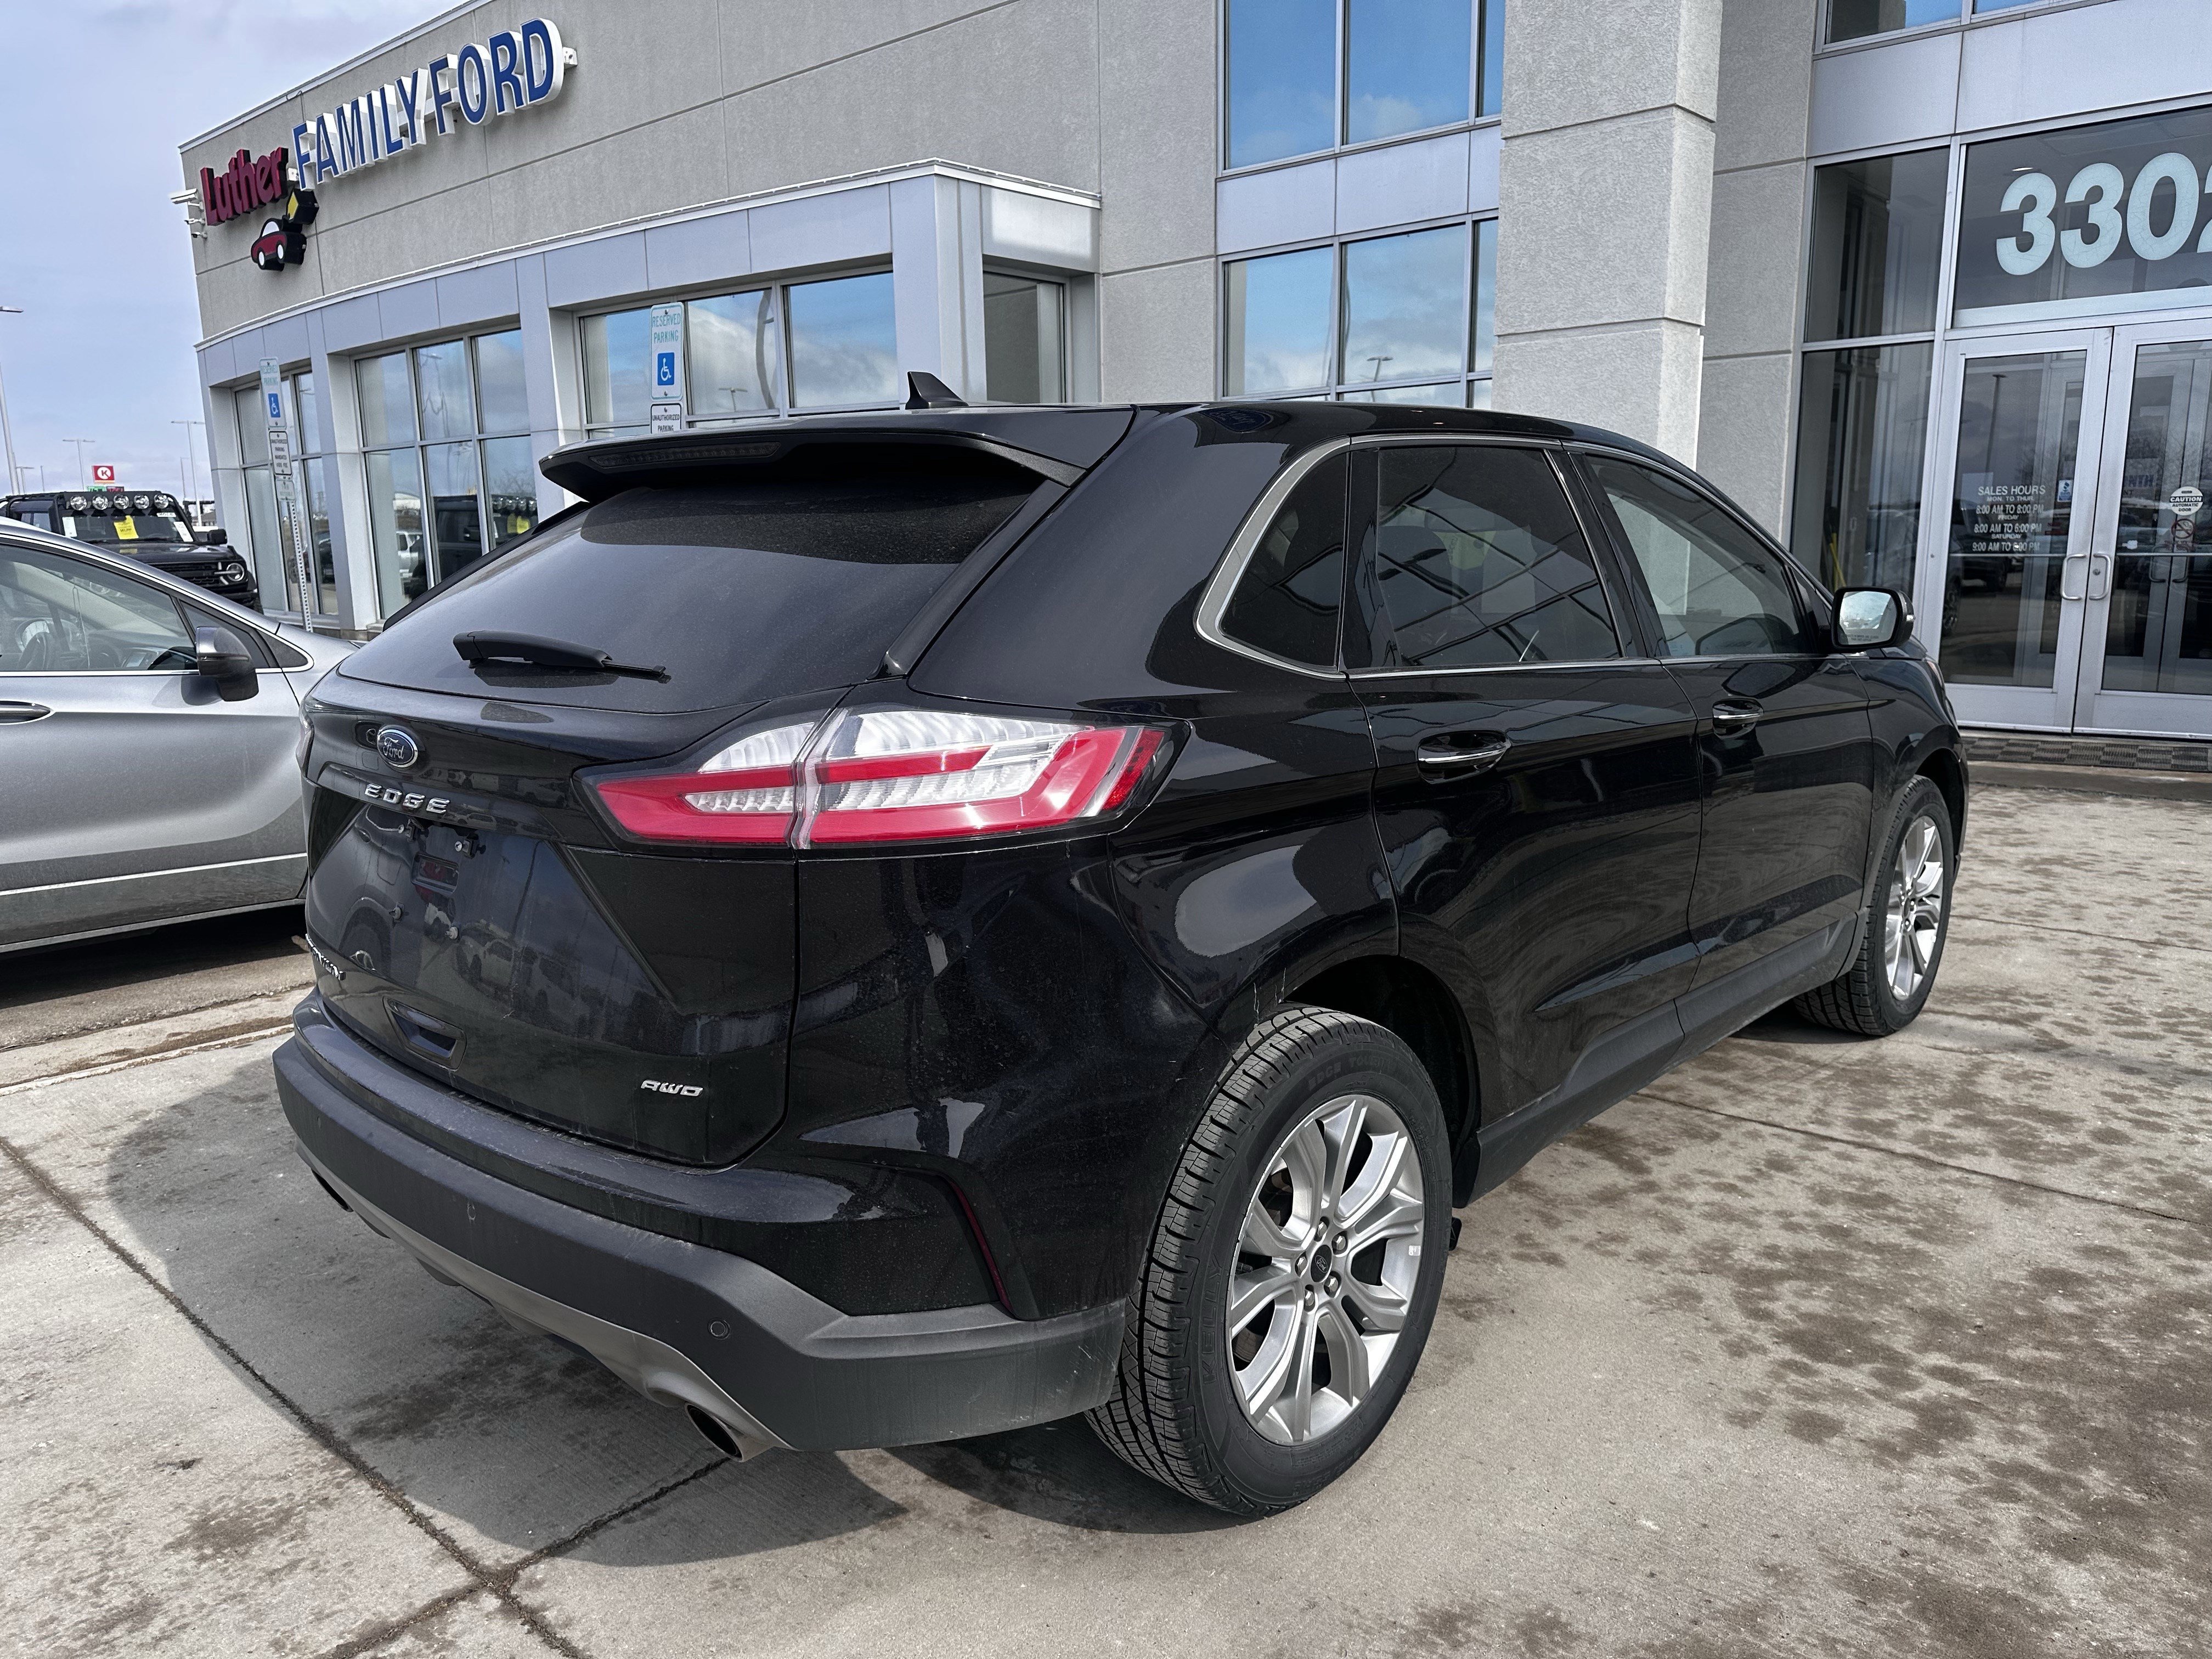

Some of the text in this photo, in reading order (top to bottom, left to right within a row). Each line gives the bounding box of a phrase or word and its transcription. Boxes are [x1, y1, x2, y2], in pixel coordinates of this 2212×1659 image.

[292, 18, 564, 191] FAMILY FORD
[200, 146, 289, 226] Luther
[1996, 152, 2212, 276] 330
[652, 313, 681, 328] RESERVED
[654, 330, 679, 343] PARKING
[101, 470, 110, 478] K
[1978, 485, 2046, 495] SALES HOURS
[1976, 504, 2044, 514] 8:00 AM TO 8:00 PM
[1974, 523, 1988, 533] 8:00
[1989, 523, 2001, 533] AM
[2004, 523, 2013, 533] TO
[2015, 523, 2029, 533] 6:00
[2030, 523, 2042, 533] PM
[1972, 542, 1987, 551] 9:00
[1988, 542, 2000, 551] AM
[2002, 542, 2011, 551] TO
[2028, 542, 2040, 551] PM
[365, 783, 450, 814] EDGE
[640, 1079, 703, 1097] AWD
[1201, 1255, 1223, 1384] KELLY
